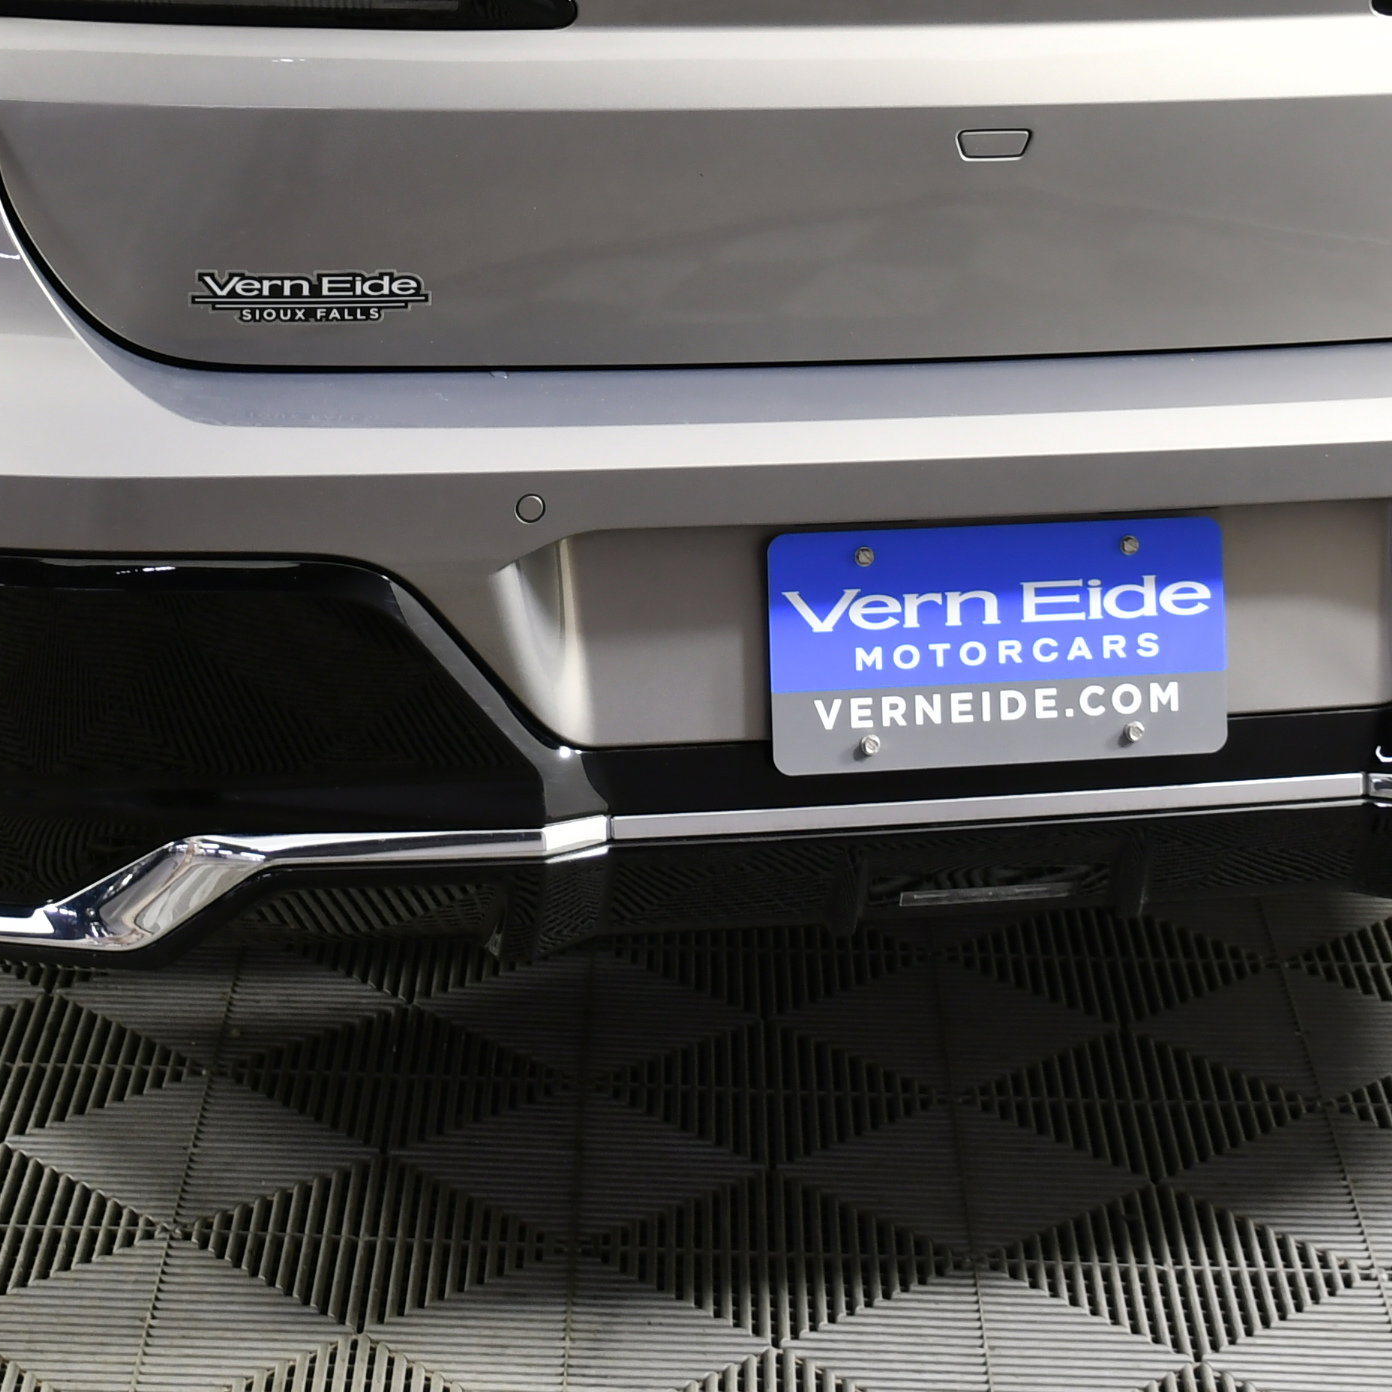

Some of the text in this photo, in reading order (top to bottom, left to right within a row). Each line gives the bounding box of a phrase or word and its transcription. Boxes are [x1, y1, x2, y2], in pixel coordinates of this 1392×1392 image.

[202, 274, 418, 296] Vern Eide
[241, 307, 380, 321] SIOUX FALLS
[782, 574, 1212, 633] Vern Eide
[854, 632, 1161, 672] MOTORCARS
[813, 681, 1181, 731] VERNEIDE.COM
